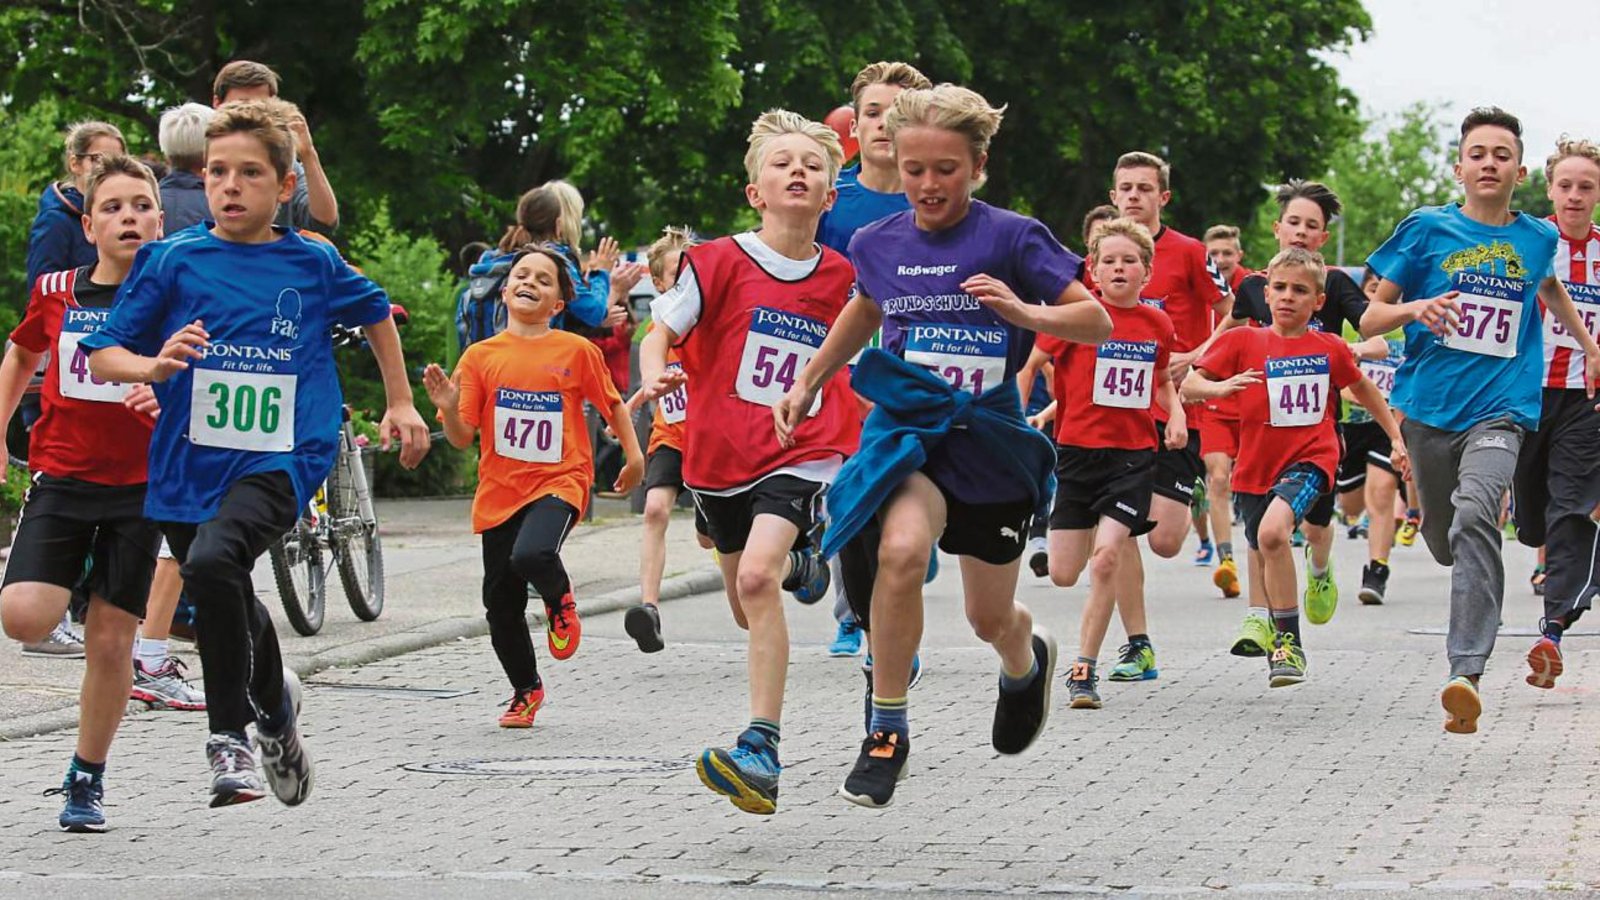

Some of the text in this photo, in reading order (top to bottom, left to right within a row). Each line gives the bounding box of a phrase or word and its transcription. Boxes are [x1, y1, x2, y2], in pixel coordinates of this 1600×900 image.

[897, 265, 958, 276] Roßwager
[1458, 272, 1524, 292] FONTANIS
[1484, 287, 1495, 296] for
[69, 310, 110, 324] FONT
[758, 309, 828, 339] FONTANIS
[1456, 302, 1513, 344] 575
[82, 324, 94, 332] Fit
[773, 327, 815, 344] Fit for life.
[914, 326, 1002, 344] FONTANIS
[203, 342, 293, 362] FONTANIS
[931, 343, 983, 355] Fit for life.
[1101, 342, 1156, 354] FONTANIS
[222, 360, 275, 373] Fit for life.
[752, 345, 811, 394] 54
[1269, 356, 1327, 372] FONTANIS
[1103, 366, 1145, 397] 454
[500, 389, 560, 403] FONTANIS
[664, 386, 686, 414] 58
[1280, 383, 1320, 414] 441
[206, 381, 282, 434] 306
[503, 417, 552, 451] 470
